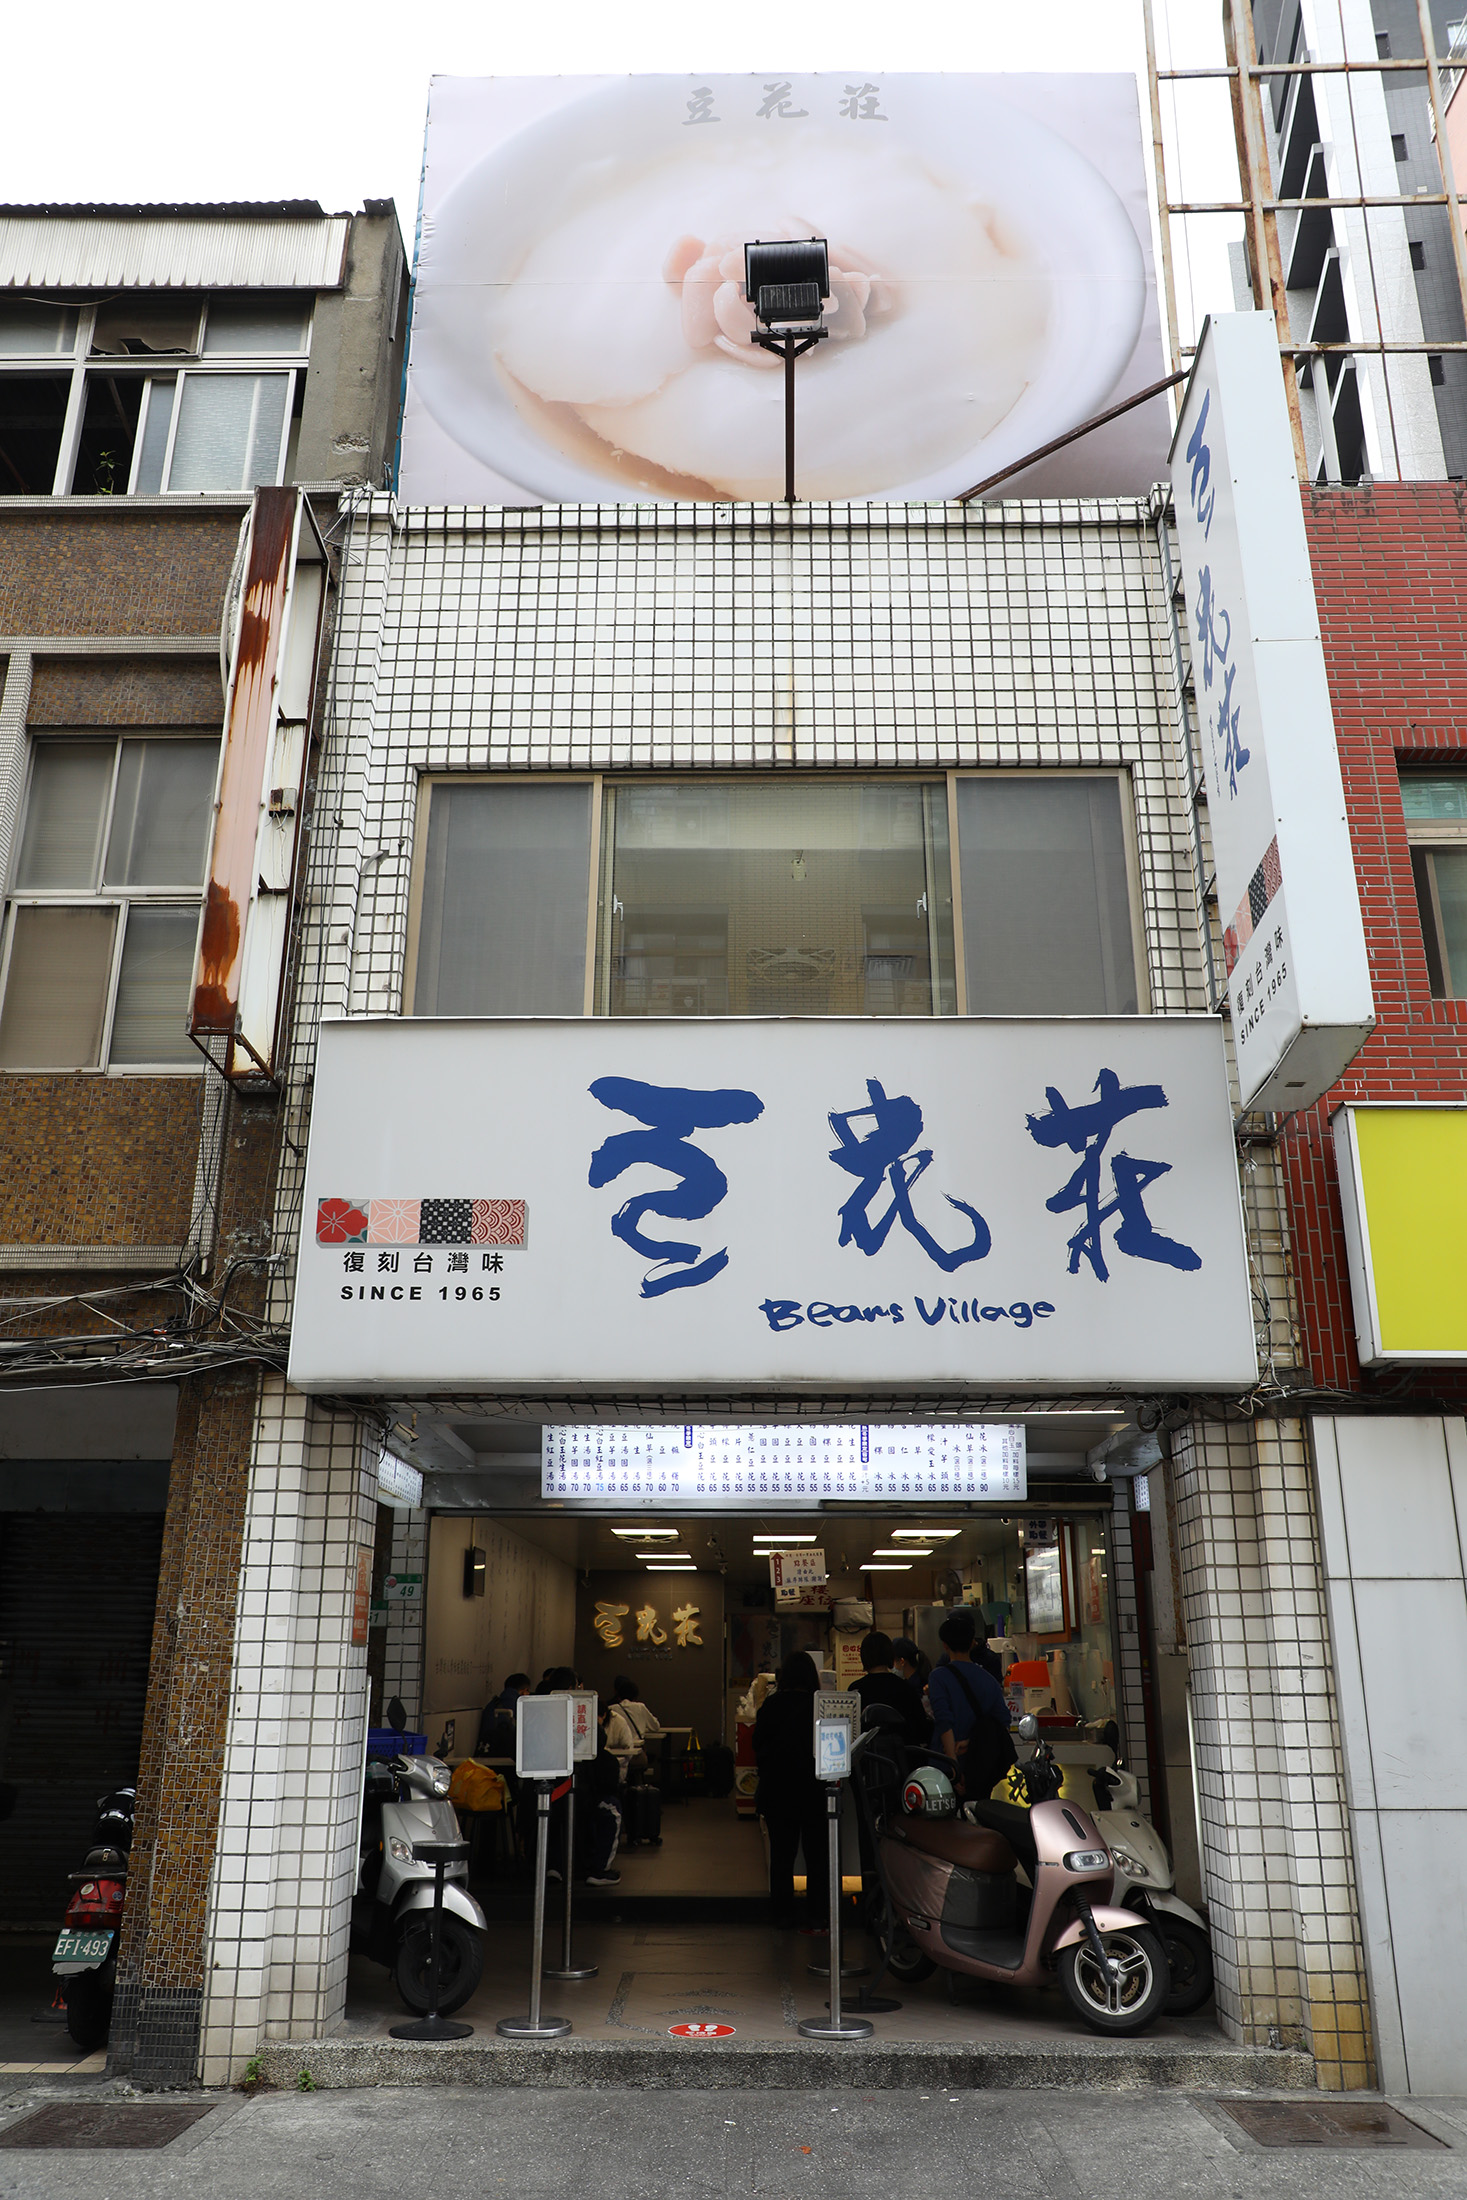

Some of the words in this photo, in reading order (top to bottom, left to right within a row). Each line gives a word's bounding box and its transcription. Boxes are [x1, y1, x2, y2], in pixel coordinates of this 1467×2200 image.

[681, 82, 889, 125] 豆花莊
[1241, 998, 1266, 1045] SINCE
[1266, 962, 1288, 1006] 1965
[343, 1251, 504, 1273] 復刻台灣味
[341, 1286, 422, 1300] SINCE
[438, 1286, 501, 1301] 1965
[914, 1296, 1056, 1328] Village
[546, 1484, 554, 1492] 70
[558, 1484, 567, 1492] 80
[571, 1484, 579, 1492] 70
[583, 1484, 591, 1492] 70
[595, 1484, 604, 1492] 75
[608, 1484, 616, 1492] 65
[620, 1484, 628, 1492] 65
[633, 1484, 641, 1492] 65
[645, 1484, 654, 1492] 70
[658, 1484, 666, 1492] 60
[671, 1484, 679, 1492] 70
[697, 1484, 705, 1492] 65
[709, 1484, 717, 1492] 65
[722, 1484, 730, 1492] 55
[735, 1484, 743, 1492] 55
[747, 1484, 756, 1492] 55
[759, 1484, 768, 1492] 55
[772, 1484, 780, 1492] 55
[784, 1484, 792, 1492] 55
[796, 1484, 805, 1492] 55
[809, 1484, 818, 1492] 55
[823, 1484, 831, 1492] 55
[836, 1484, 844, 1492] 55
[848, 1484, 856, 1492] 55
[874, 1484, 883, 1492] 55
[887, 1484, 896, 1492] 55
[901, 1484, 910, 1492] 55
[914, 1484, 923, 1492] 55
[927, 1484, 936, 1492] 65
[940, 1484, 949, 1492] 85
[953, 1484, 962, 1492] 85
[966, 1484, 975, 1492] 85
[979, 1484, 988, 1492] 90
[400, 1586, 415, 1598] 49
[926, 1798, 950, 1811] LET'S
